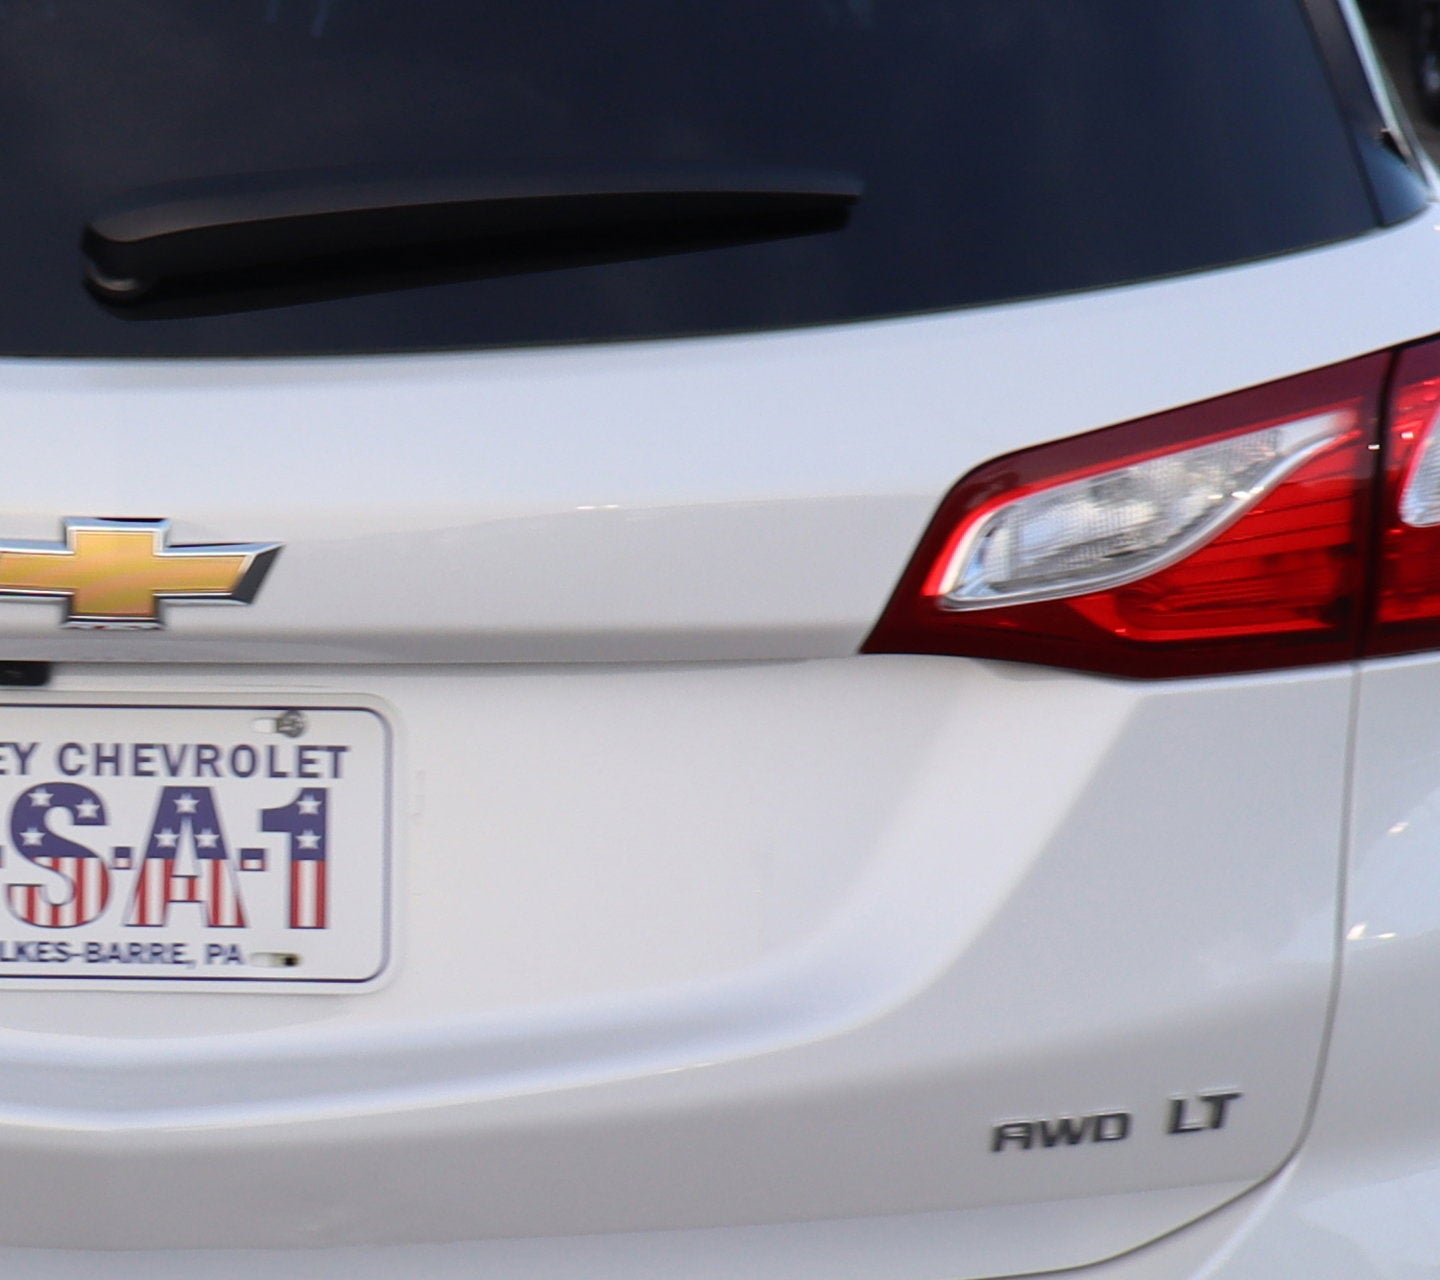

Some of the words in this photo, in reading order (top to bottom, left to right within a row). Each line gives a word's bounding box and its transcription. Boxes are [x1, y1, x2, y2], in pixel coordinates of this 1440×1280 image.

[56, 742, 350, 779] CHEVROLET
[204, 942, 245, 965] PA
[990, 1111, 1132, 1153] AWD
[1166, 1091, 1243, 1135] LT
